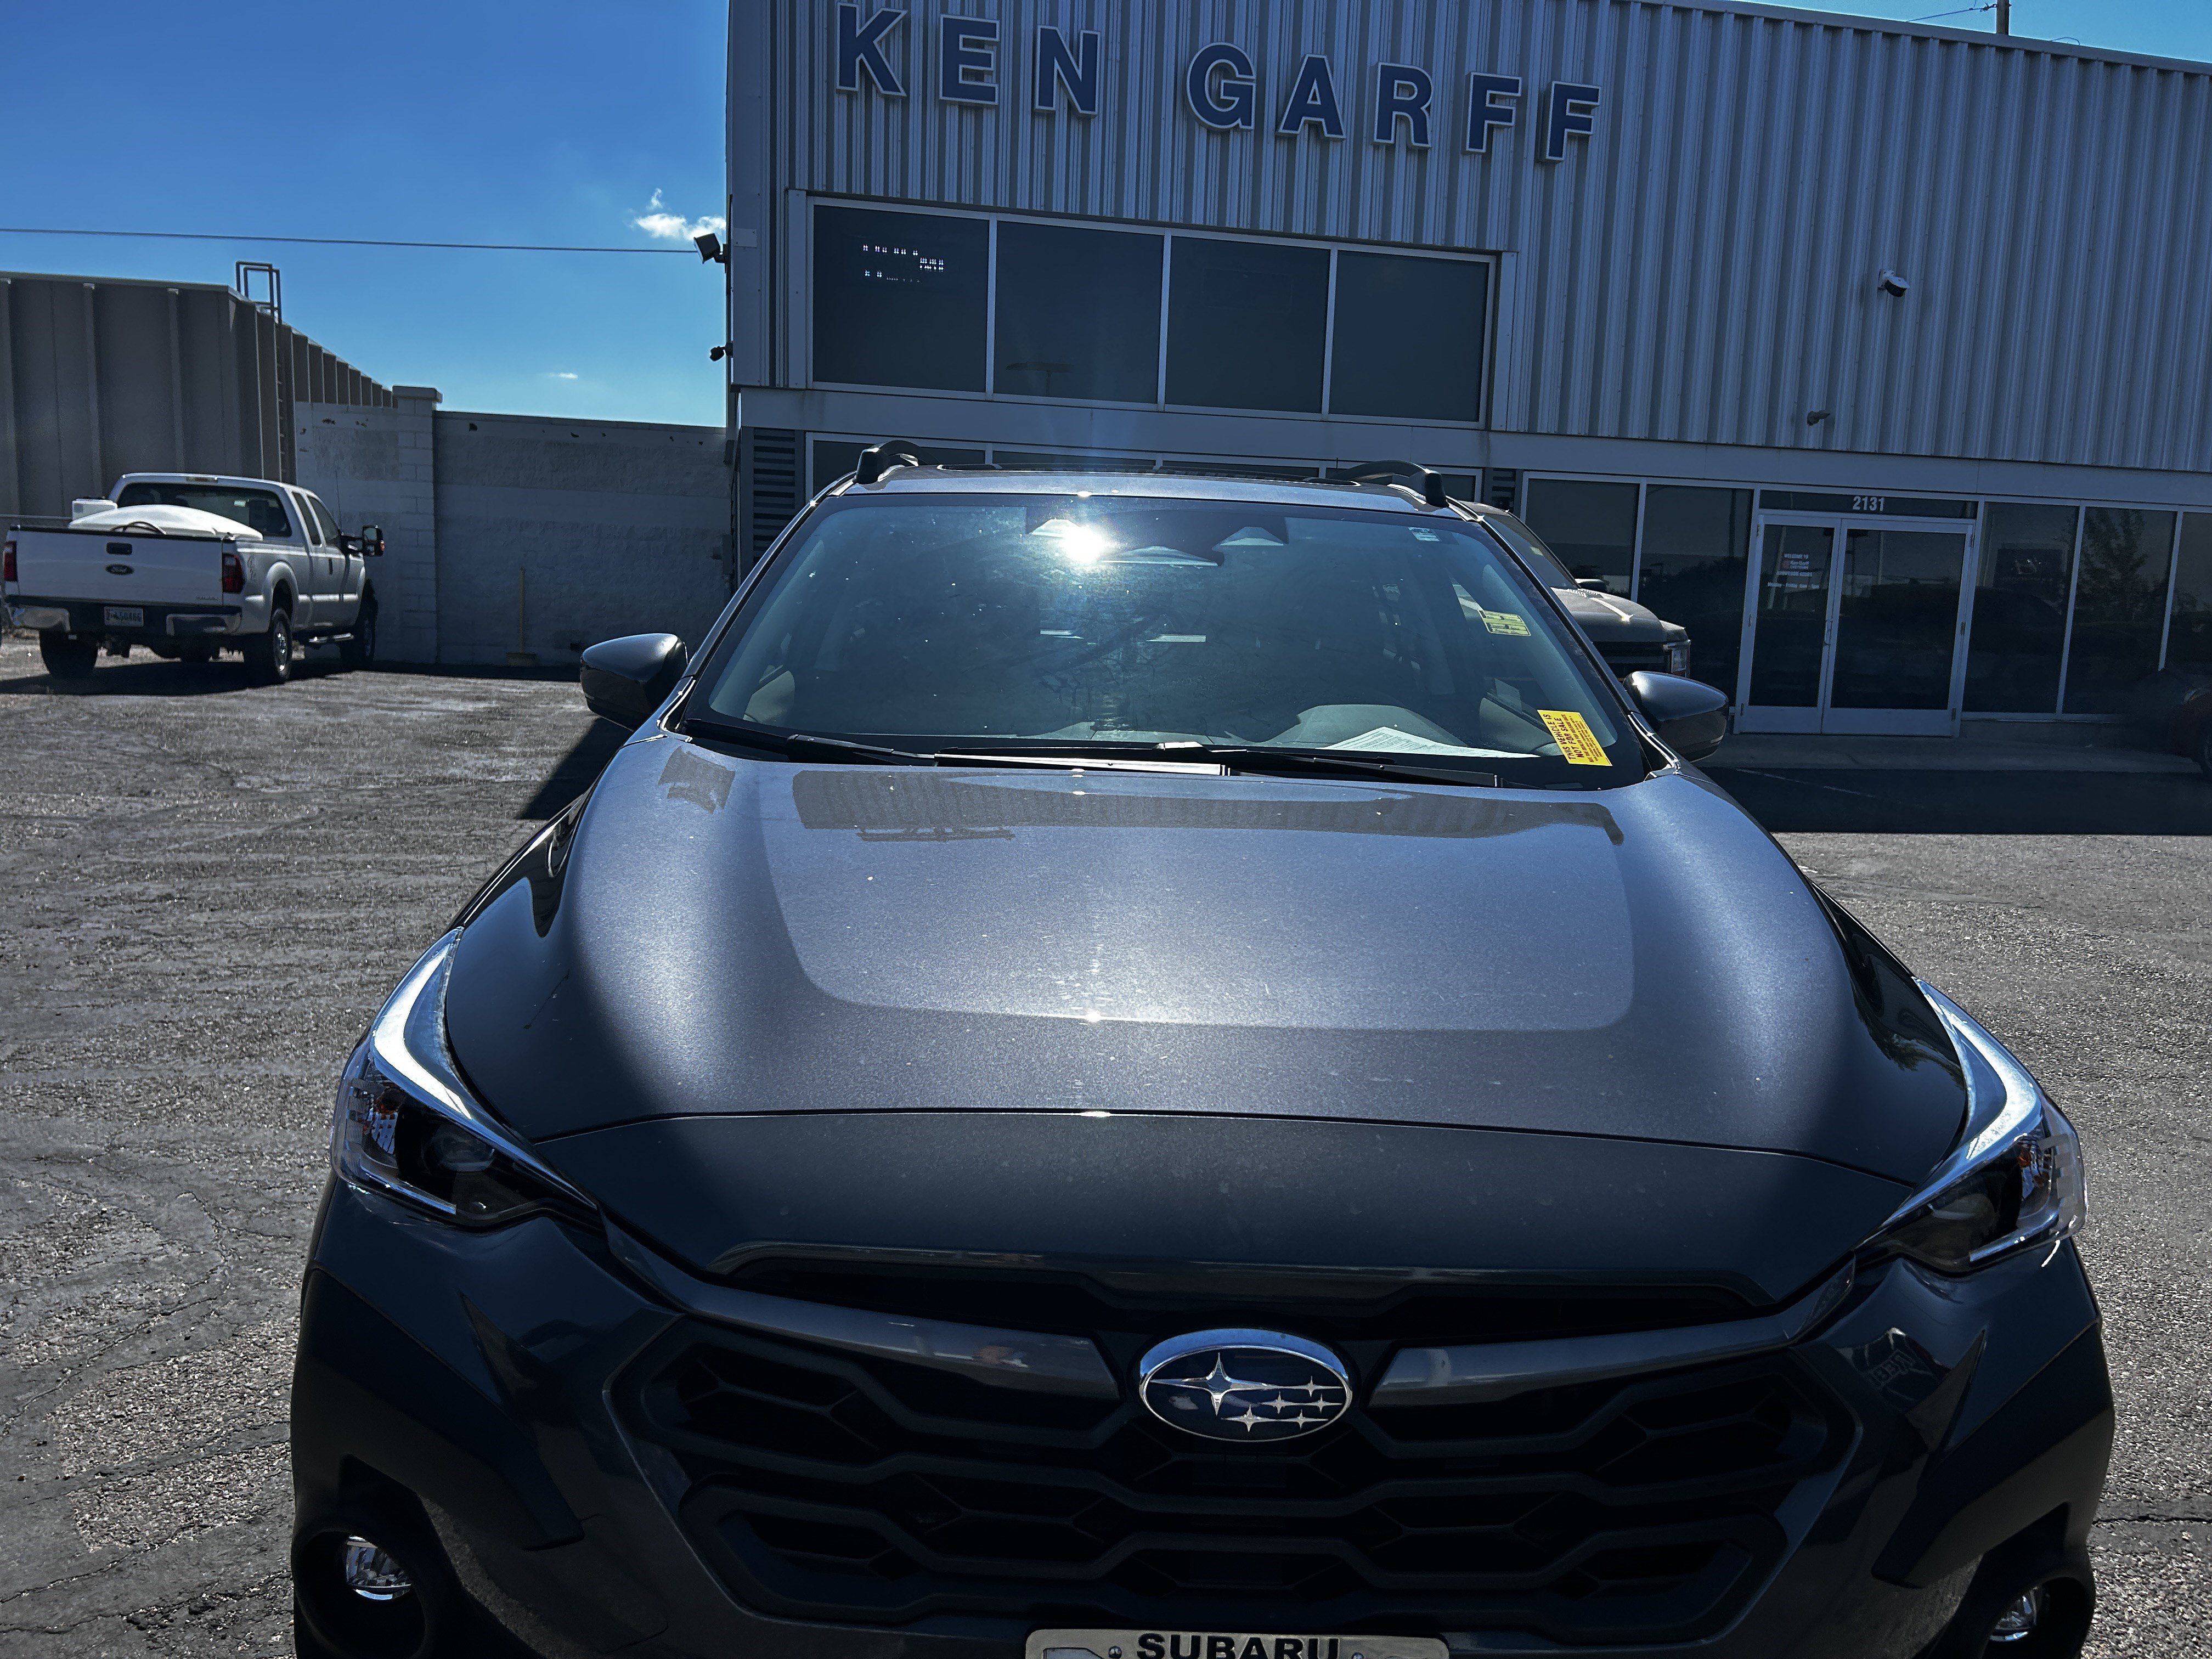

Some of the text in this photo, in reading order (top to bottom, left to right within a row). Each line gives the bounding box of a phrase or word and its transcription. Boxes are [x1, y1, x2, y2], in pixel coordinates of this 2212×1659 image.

[836, 3, 1601, 161] KEN GARFF
[1853, 496, 1884, 511] 2131
[1555, 718, 1568, 731] SALE
[1548, 721, 1567, 745] VEHICLE
[1564, 733, 1576, 744] FOR
[1563, 747, 1576, 759] THIS
[1571, 746, 1584, 758] NOT
[1137, 1632, 1339, 1659] SUBARU
